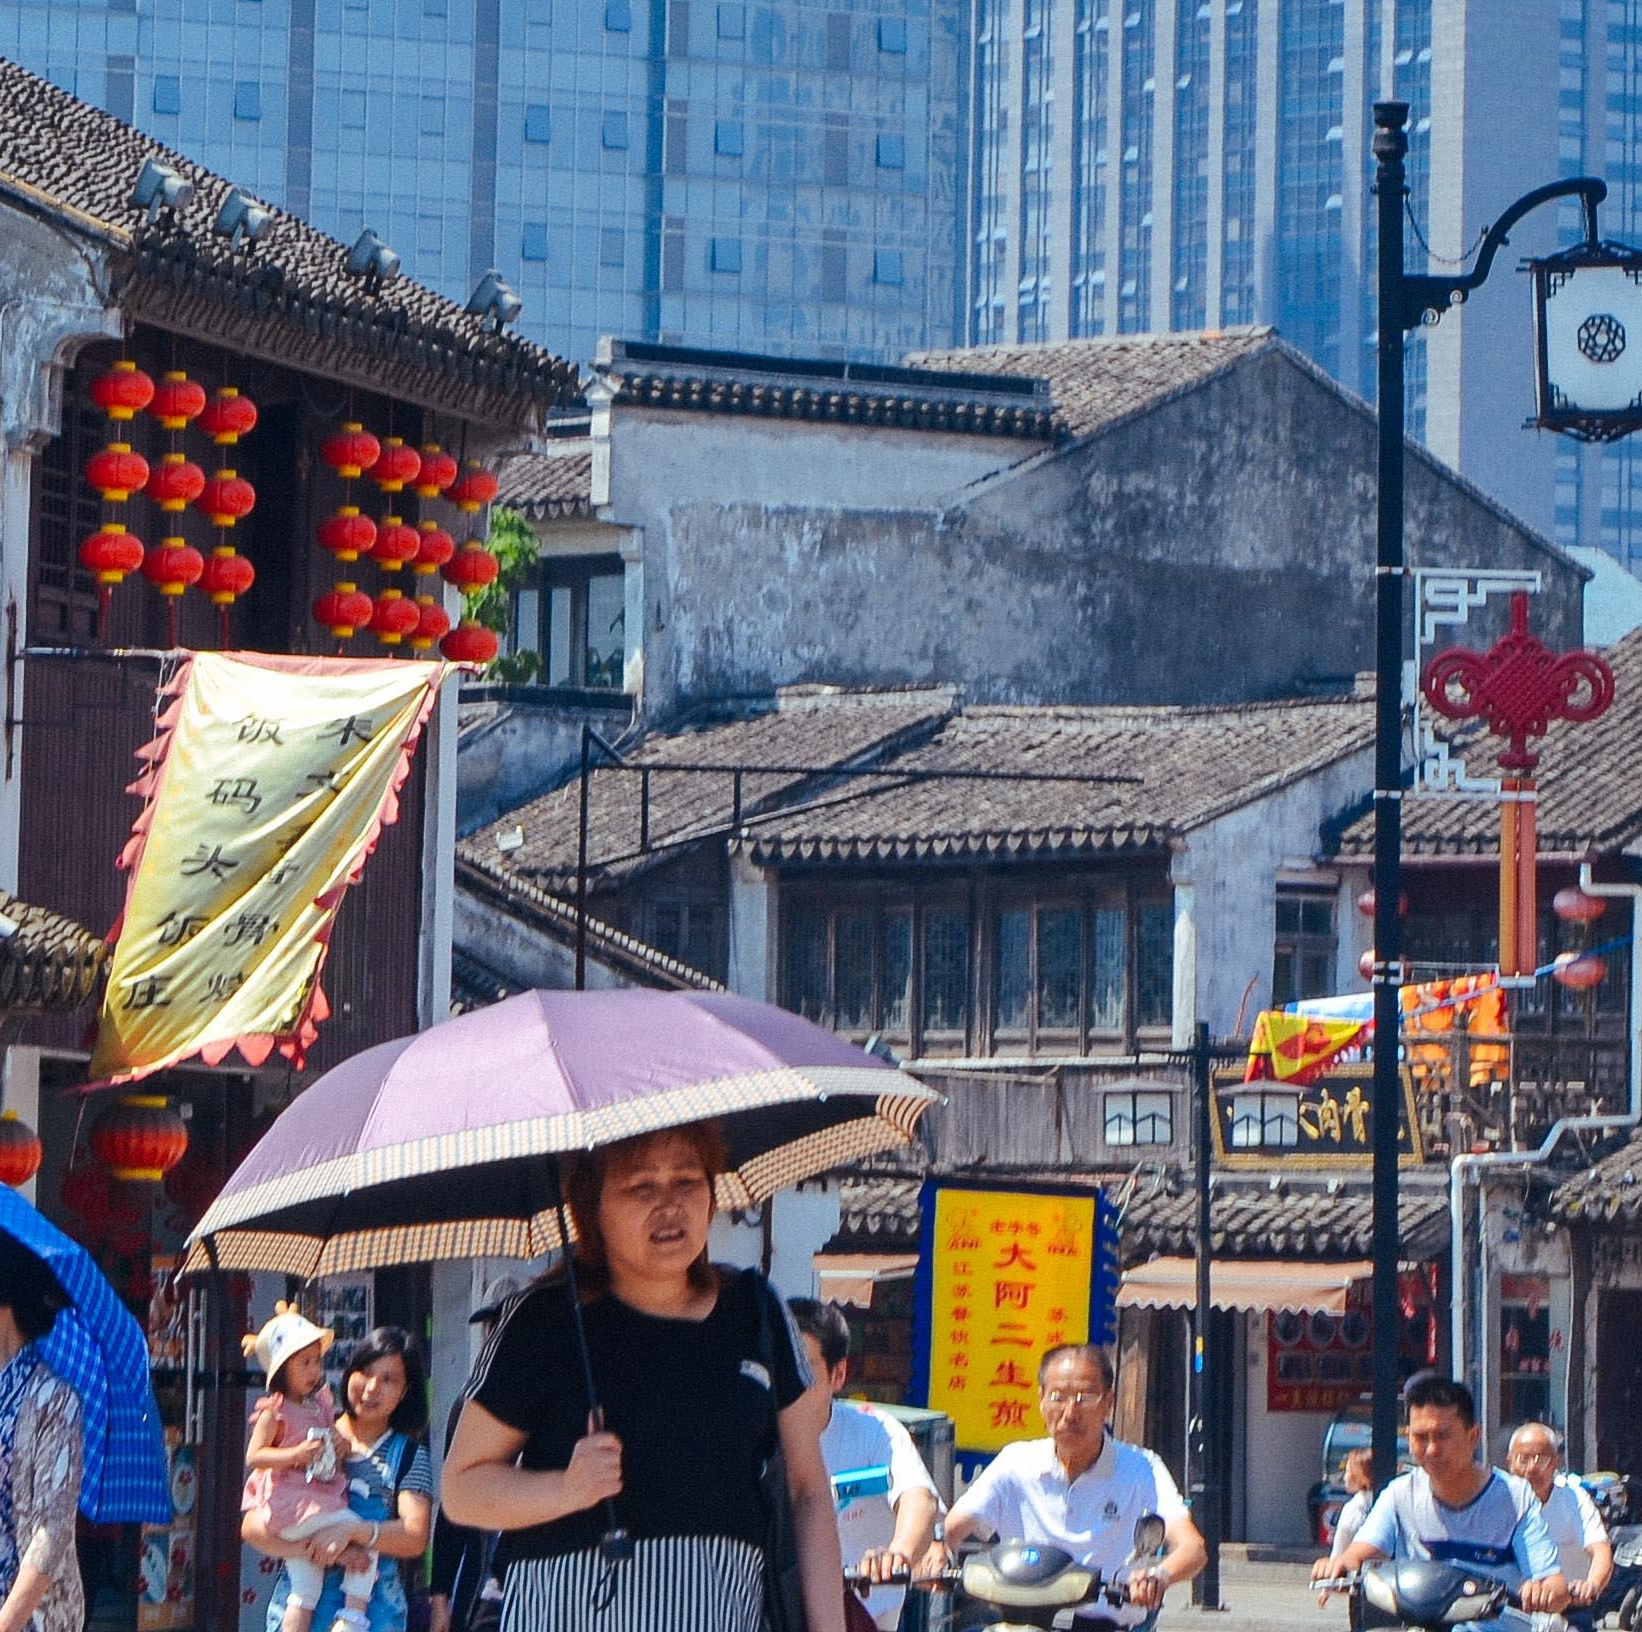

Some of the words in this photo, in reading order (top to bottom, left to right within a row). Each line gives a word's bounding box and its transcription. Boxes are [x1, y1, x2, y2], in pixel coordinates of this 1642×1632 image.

[122, 714, 286, 1010] 饭码头饭庄
[989, 1242, 1038, 1429] 大阿二生煎
